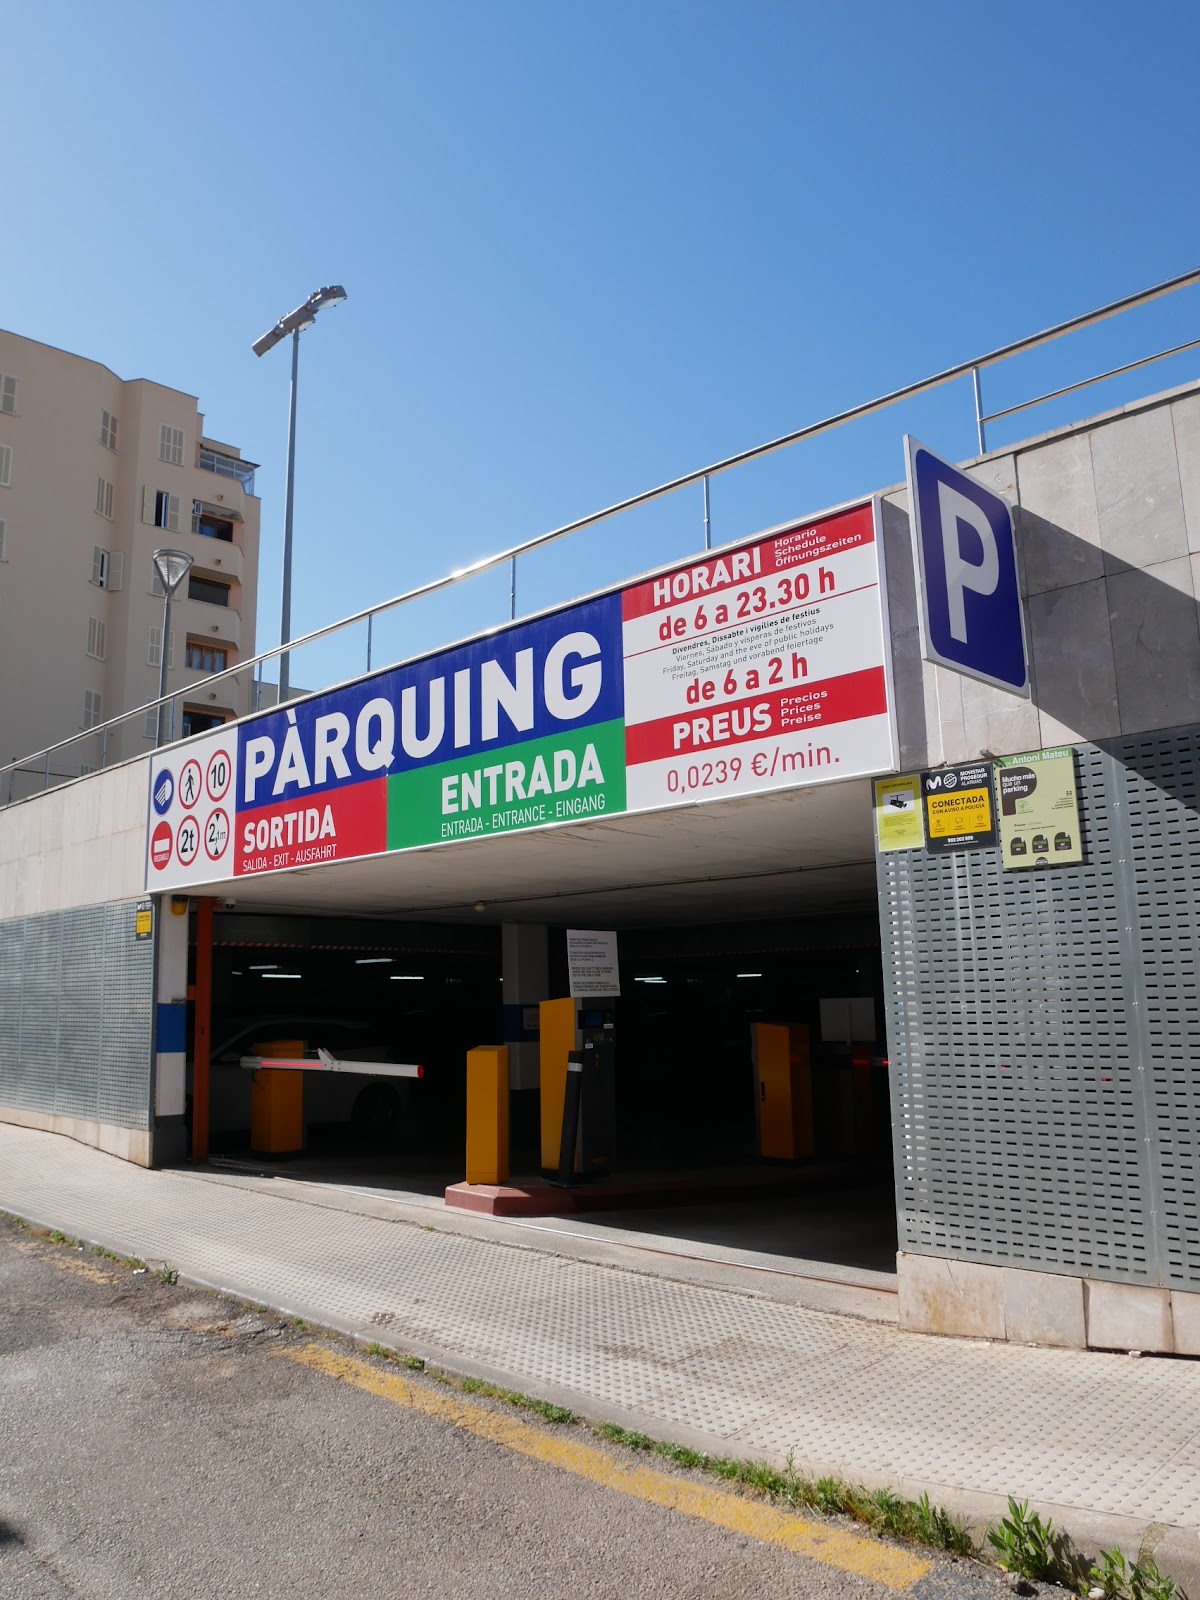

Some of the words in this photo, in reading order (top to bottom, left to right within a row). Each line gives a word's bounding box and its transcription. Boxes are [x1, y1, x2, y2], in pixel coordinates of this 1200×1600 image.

[774, 529, 817, 548] Horario
[774, 535, 827, 557] Schedule
[775, 534, 862, 567] Öffnungszeiten
[653, 547, 762, 607] HORARI
[937, 479, 1000, 644] P
[659, 615, 687, 641] de
[694, 605, 708, 630] 6
[715, 604, 729, 625] a
[737, 573, 810, 618] 23.30
[819, 566, 836, 594] h
[663, 664, 686, 675] Friday,
[687, 653, 719, 668] Saturday
[720, 649, 734, 660] and
[735, 647, 748, 655] the
[750, 643, 763, 651] eve
[764, 639, 772, 647] of
[774, 633, 798, 645] public
[800, 623, 834, 637] holidays
[672, 639, 711, 655] Divendres,
[712, 629, 744, 644] Dissabte
[780, 616, 790, 624] de
[792, 607, 821, 621] festius
[676, 650, 705, 662] Viernes,
[734, 640, 739, 648] y
[774, 627, 784, 635] de
[786, 618, 817, 632] festivos
[672, 669, 699, 681] Freitag,
[700, 660, 732, 673] Samstag
[733, 654, 747, 665] und
[748, 644, 785, 660] vorabend
[787, 635, 824, 650] feiertage
[686, 678, 716, 705] de
[723, 668, 737, 695] 6
[745, 669, 760, 690] a
[768, 657, 784, 685] 2
[791, 652, 808, 680] h
[244, 631, 603, 803] PÀRQUING
[780, 690, 828, 707] Precios
[780, 702, 821, 717] Prices
[673, 702, 772, 750] PREUS
[781, 712, 822, 727] Preise
[211, 762, 226, 788] 10
[667, 757, 742, 795] 0,0239
[751, 742, 840, 777] €/min.
[960, 767, 986, 776] MOVISTAR
[1012, 754, 1040, 765] Antoni
[1042, 750, 1069, 760] Mateu
[441, 743, 605, 815] ENTRADA
[1002, 774, 1022, 783] Mucho
[1003, 785, 1029, 795] parking
[441, 816, 484, 838] ENTRADA
[492, 804, 546, 829] ENTRANCE
[556, 793, 606, 818] EINGANG
[932, 795, 985, 809] CONECTADA
[181, 828, 194, 853] 2t
[243, 804, 337, 854] SORTIDA
[243, 857, 268, 872] SALIDA
[273, 852, 290, 867] EXIT
[295, 844, 337, 863] AUSFAHRT
